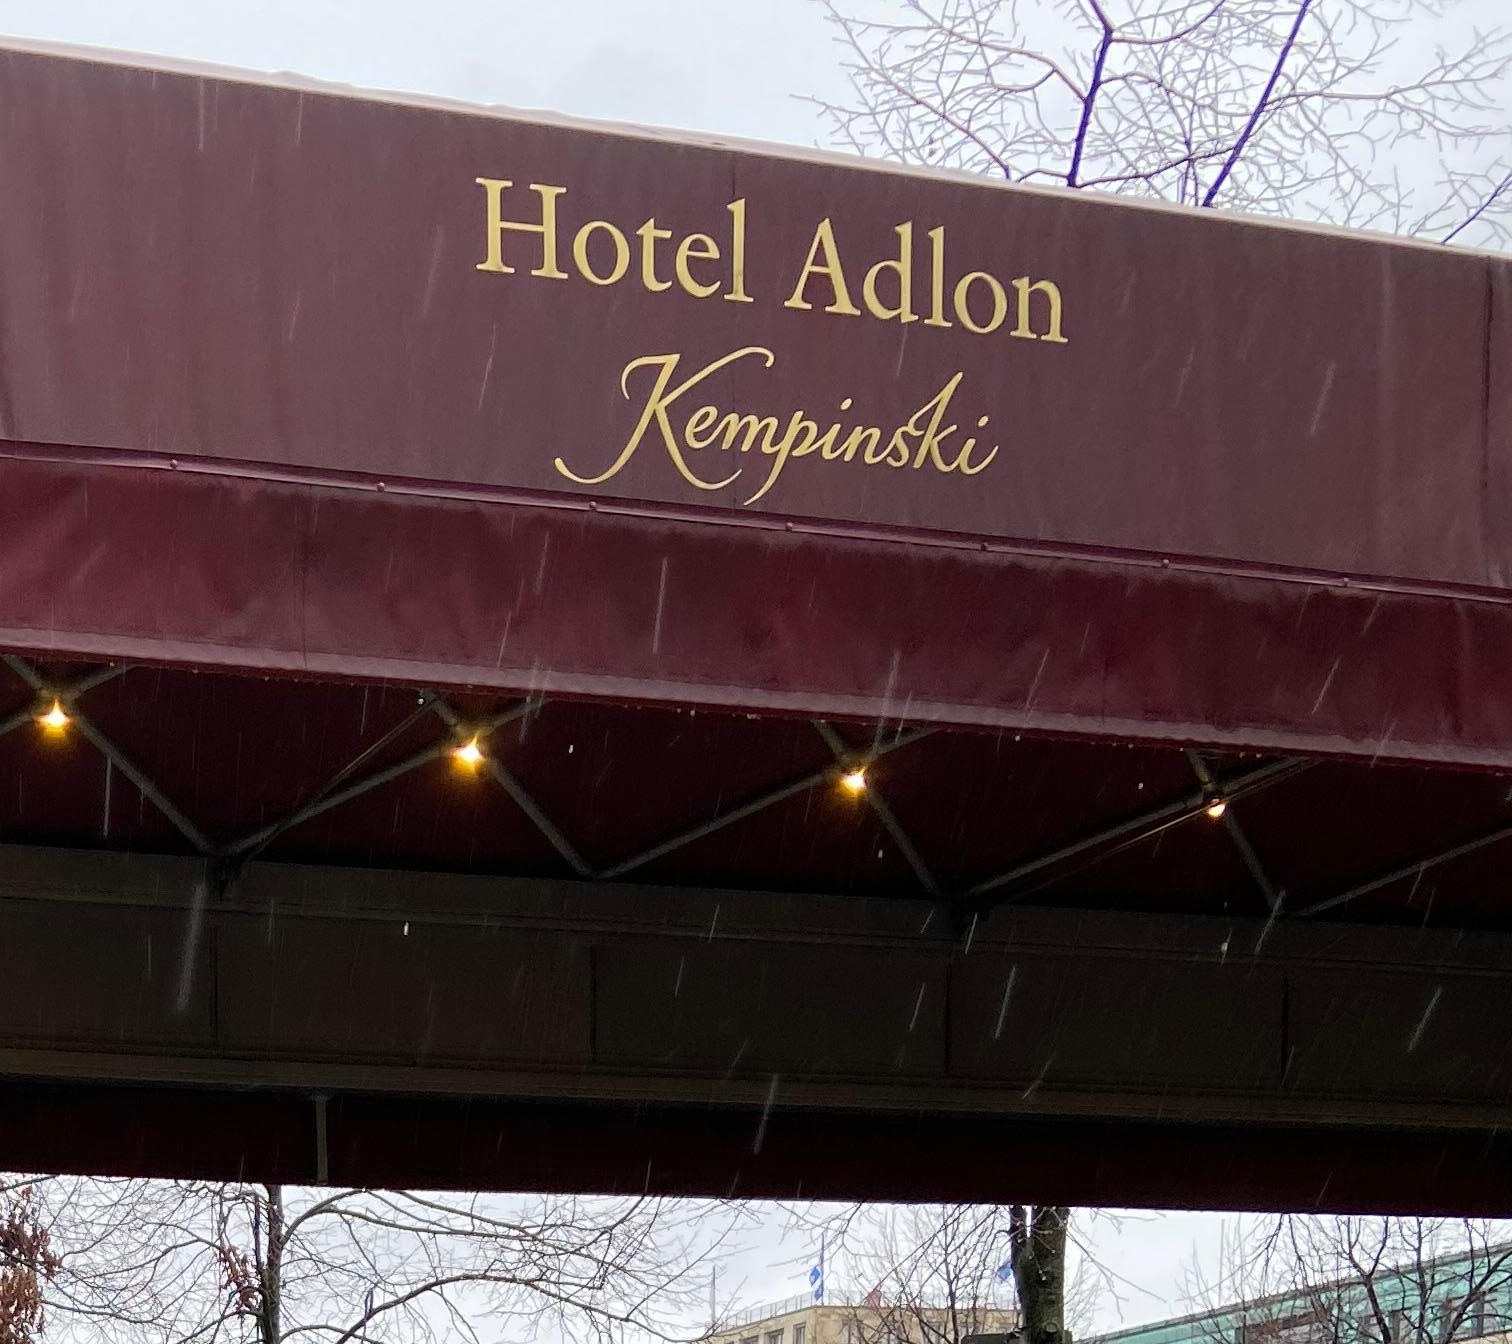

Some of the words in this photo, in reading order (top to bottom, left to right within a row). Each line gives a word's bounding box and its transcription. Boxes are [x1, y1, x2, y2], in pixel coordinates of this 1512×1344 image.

[475, 177, 754, 303] Hotel
[784, 217, 1069, 343] Adlon
[554, 346, 999, 506] Kempinski
